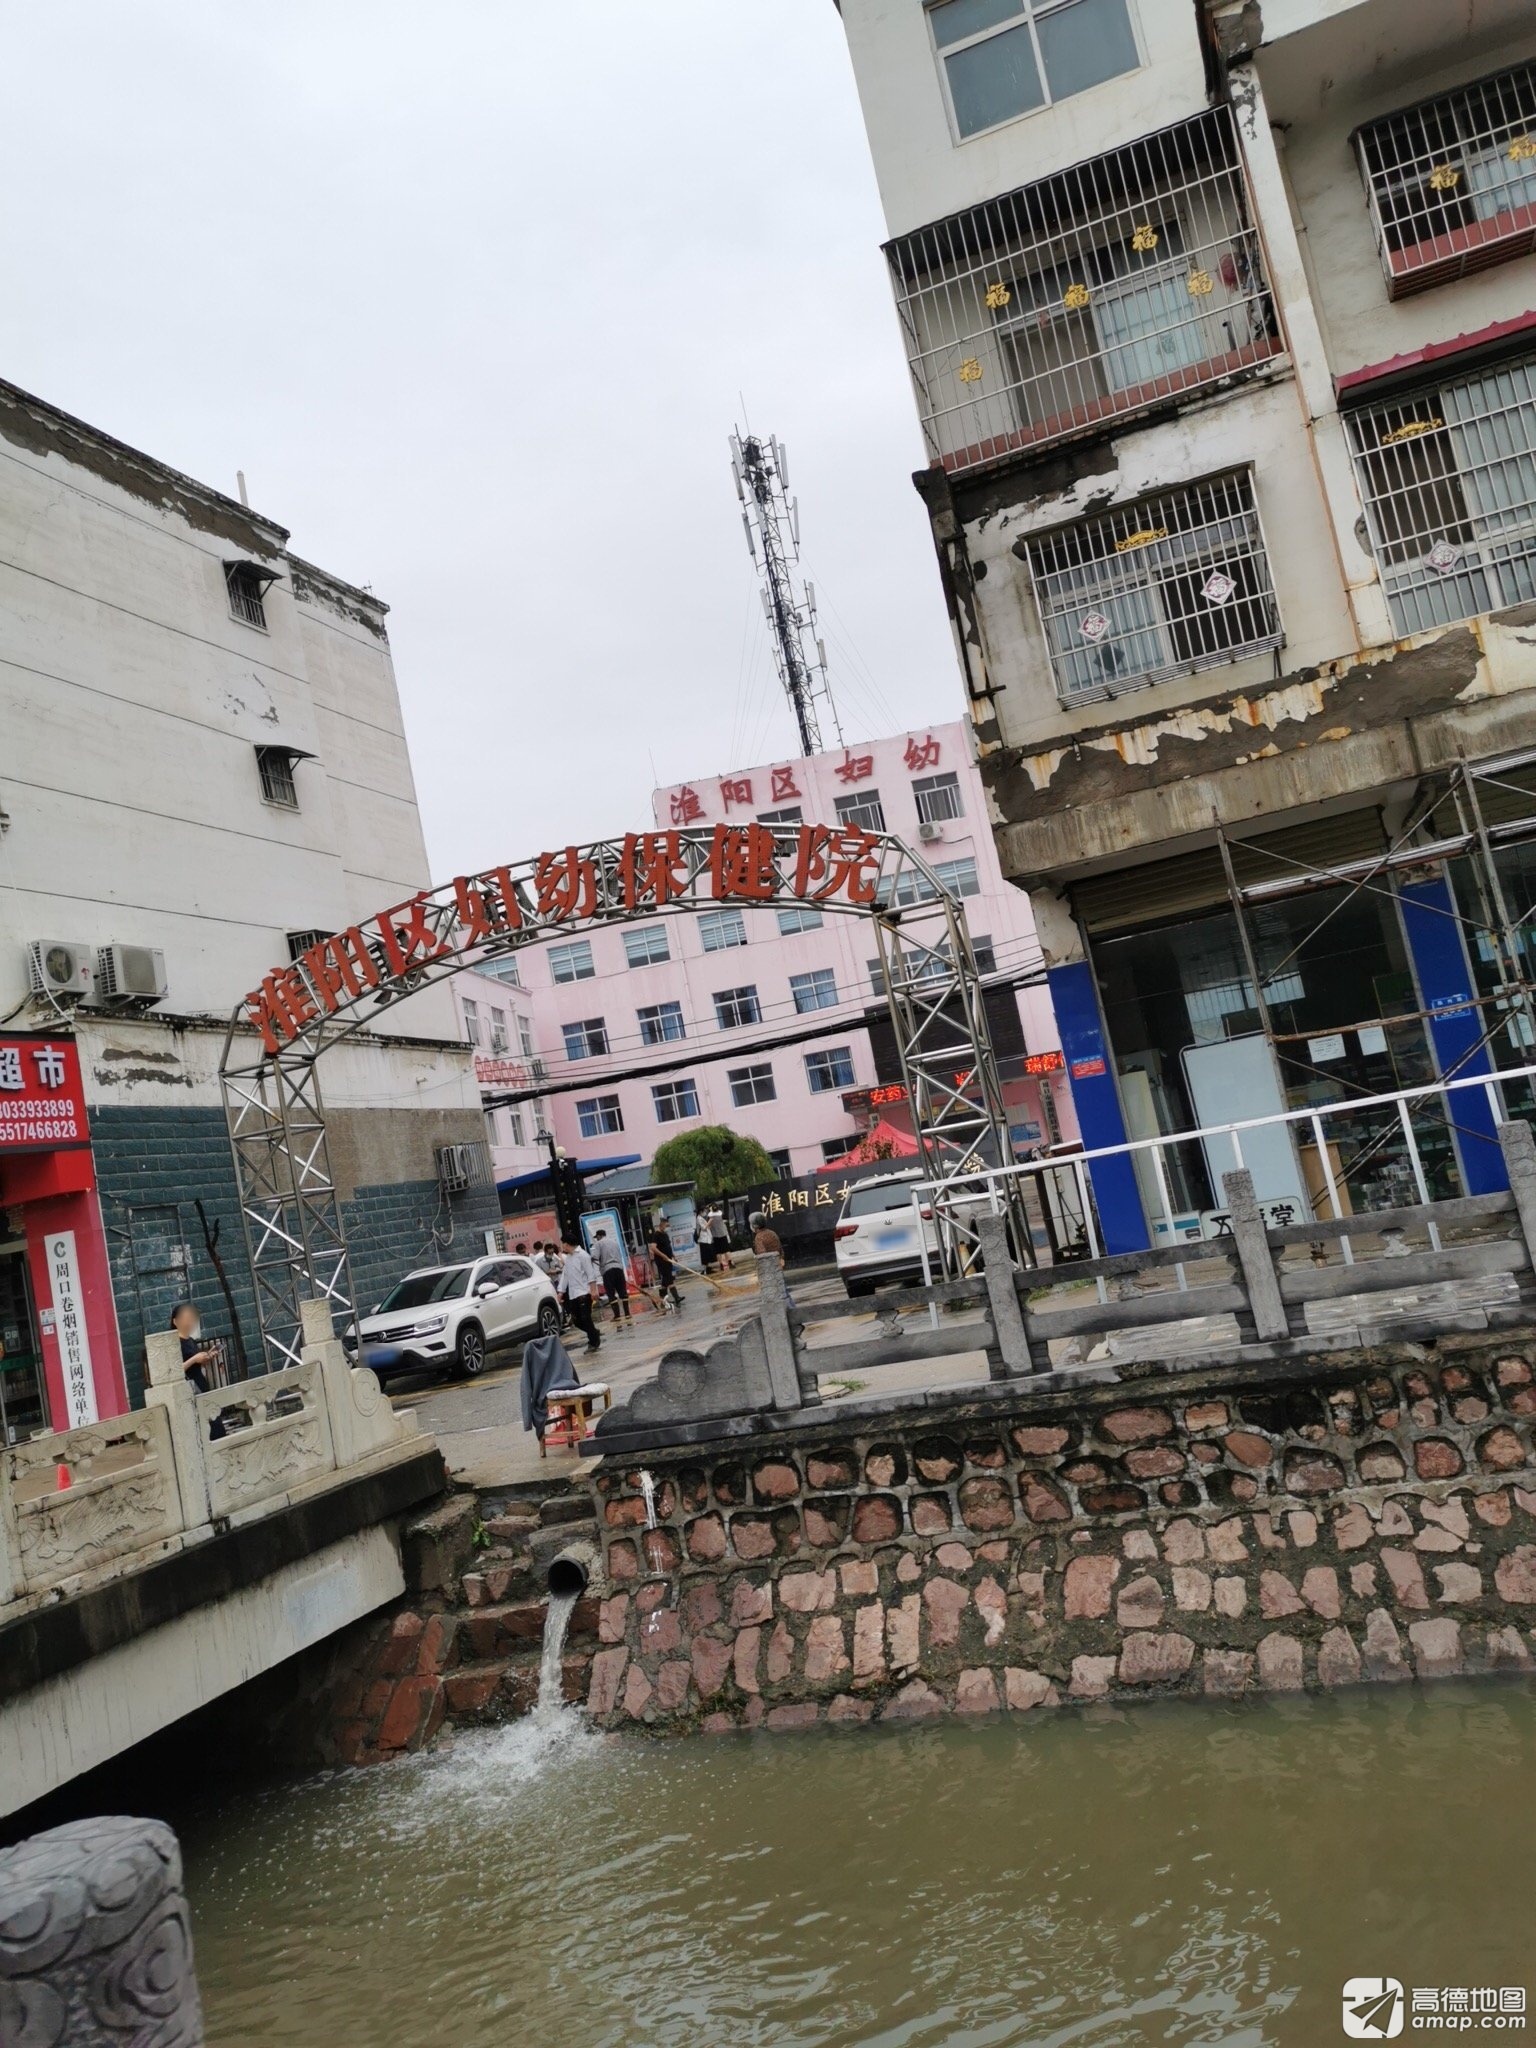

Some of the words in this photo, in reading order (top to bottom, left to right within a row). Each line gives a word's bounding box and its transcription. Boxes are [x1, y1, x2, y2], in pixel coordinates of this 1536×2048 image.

[1132, 224, 1158, 251] 福
[985, 281, 1010, 308] 福
[1064, 284, 1089, 308] 福
[1187, 270, 1214, 297] 福
[959, 357, 983, 383] 福
[670, 734, 941, 826] 淮阳区妇幼
[246, 822, 881, 1054] 淮阳区妇幼保健院
[0, 1045, 65, 1089] 超市
[1210, 1204, 1295, 1238] 五堂
